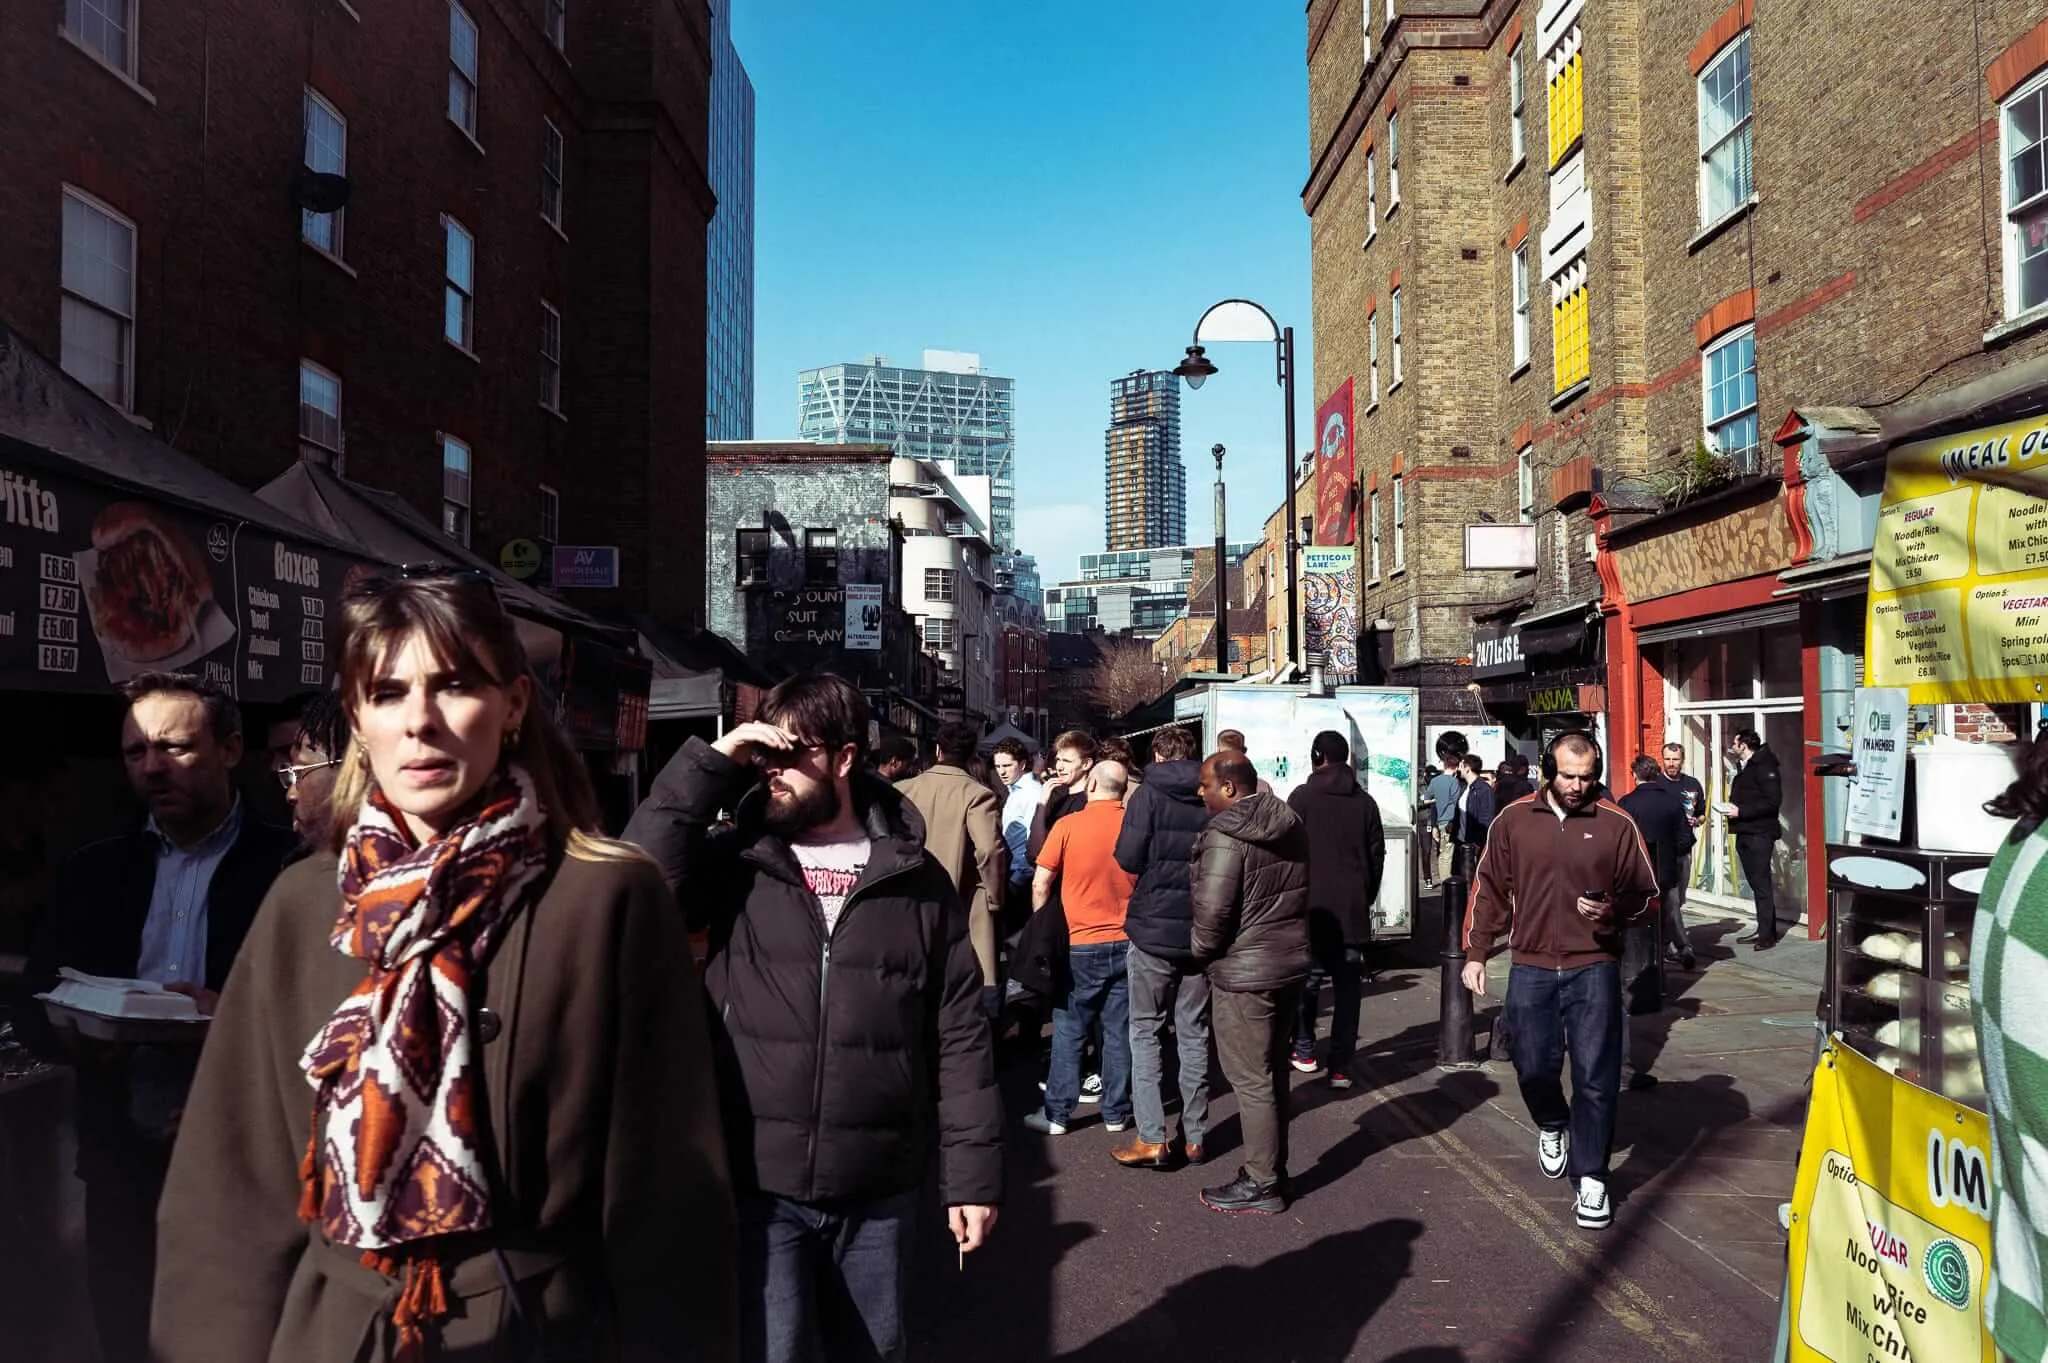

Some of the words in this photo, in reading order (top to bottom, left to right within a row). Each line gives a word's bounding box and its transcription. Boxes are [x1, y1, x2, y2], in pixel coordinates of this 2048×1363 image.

[1904, 507, 1935, 523] REGULAR
[2025, 518, 2048, 531] with
[1895, 525, 1940, 542] Noodle/Rice
[1906, 541, 1926, 552] with
[2009, 538, 2026, 551] Mix
[274, 541, 320, 588] Boxes
[574, 550, 596, 566] AV
[1906, 553, 1940, 565] Chicken
[45, 586, 76, 612] £7.50
[1975, 591, 2000, 600] Option
[2003, 597, 2048, 610] VEGETAR
[788, 610, 818, 624] SUIT
[1876, 606, 1898, 616] Option
[1904, 609, 1937, 624] VEGETARIAN
[2015, 615, 2040, 627] Mini
[1896, 626, 1924, 640] Specially
[1908, 640, 1938, 652] Vegetable
[2000, 635, 2031, 649] Spring
[2032, 632, 2048, 645] rol
[1476, 641, 1494, 668] 24/7
[1894, 656, 1912, 666] with
[247, 660, 264, 680] Mix
[1827, 1158, 1857, 1187] Optio
[1846, 1300, 1870, 1339] Mix
[1872, 1324, 1912, 1362] Chi
